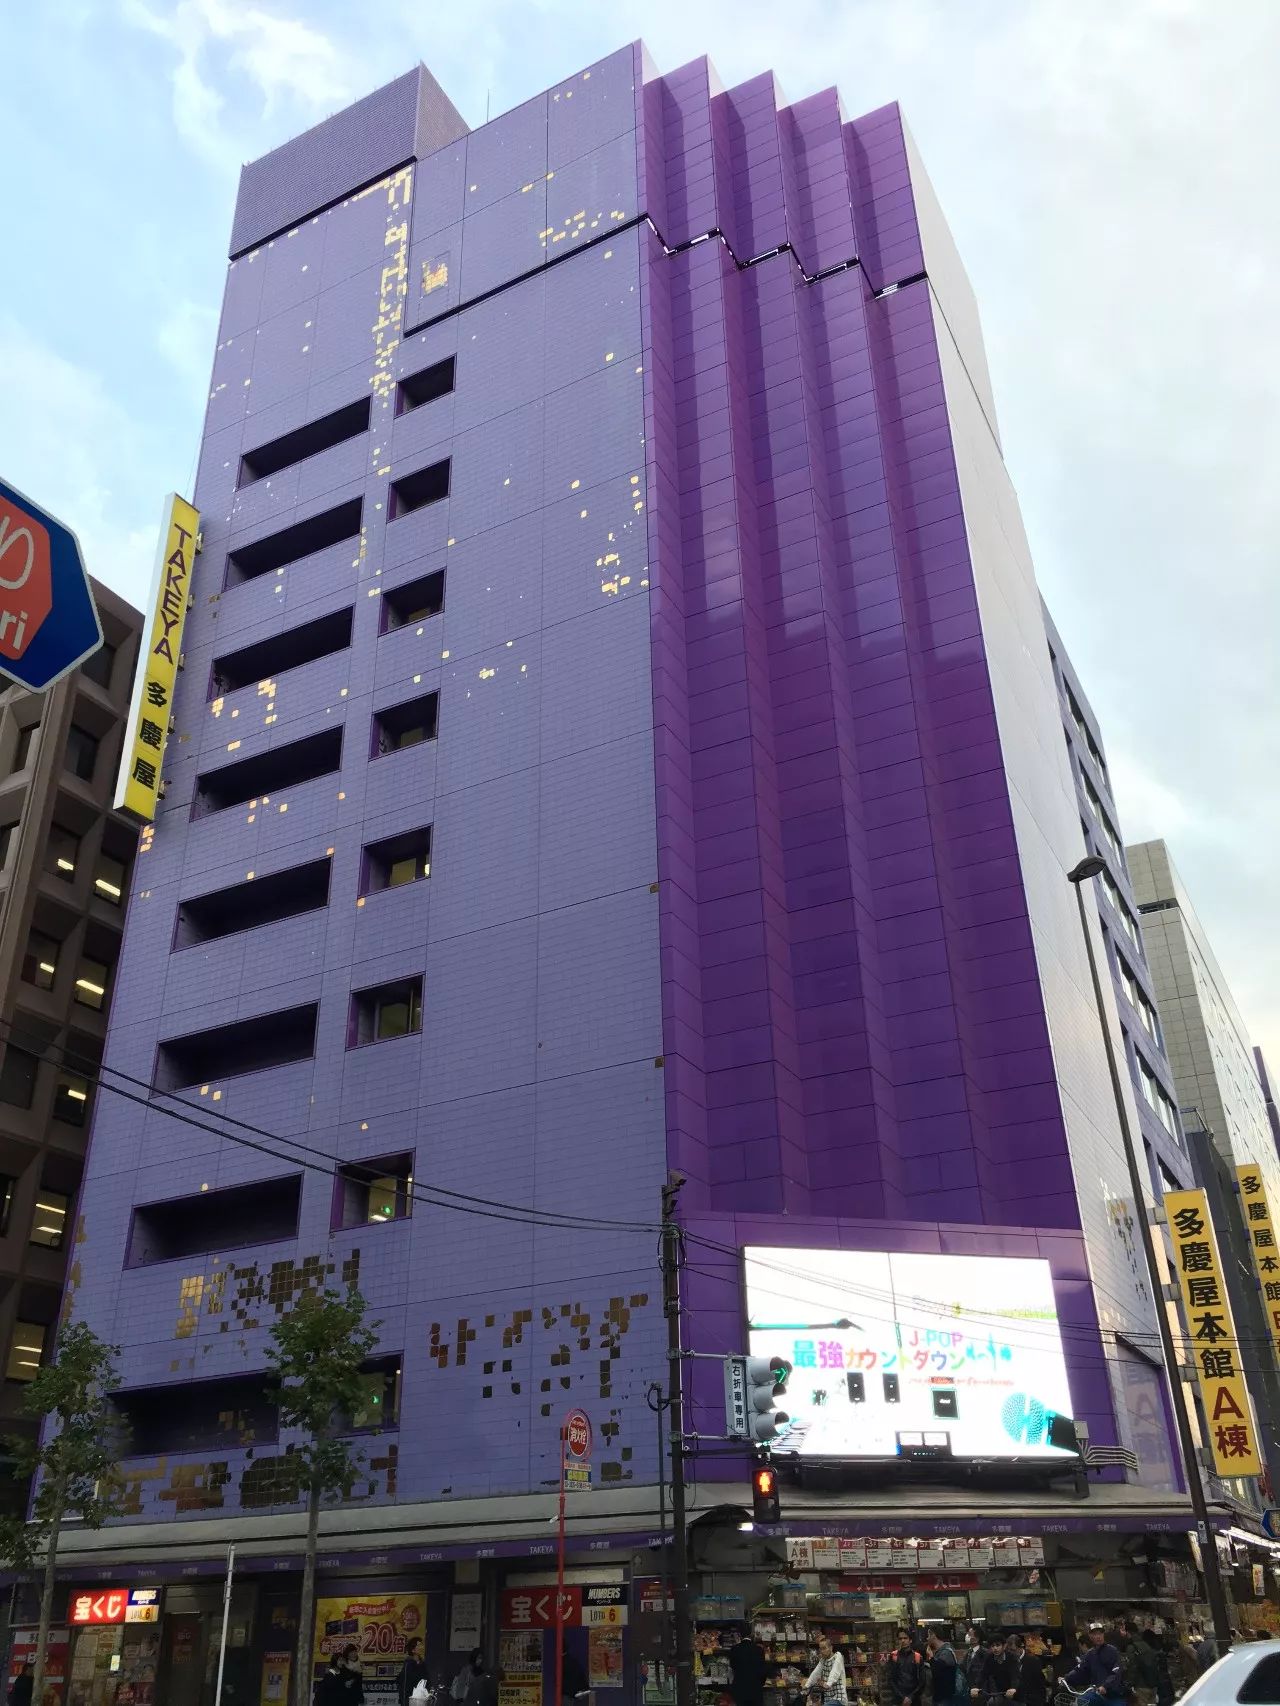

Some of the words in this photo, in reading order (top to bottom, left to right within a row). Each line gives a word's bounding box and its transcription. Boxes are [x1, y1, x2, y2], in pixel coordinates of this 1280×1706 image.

[153, 522, 194, 666] TAKEYA
[131, 680, 168, 791] 多慶屋
[792, 1339, 967, 1372] 最強カウントダウン
[731, 1365, 745, 1429] 右折車専用
[822, 1527, 849, 1535] TAKEYA
[419, 1553, 443, 1561] TAKEYA
[529, 1545, 554, 1554] TAKEYA
[587, 1587, 621, 1600] NUMBERS
[73, 1595, 122, 1621] 宝くじ
[608, 1608, 616, 1622] 6
